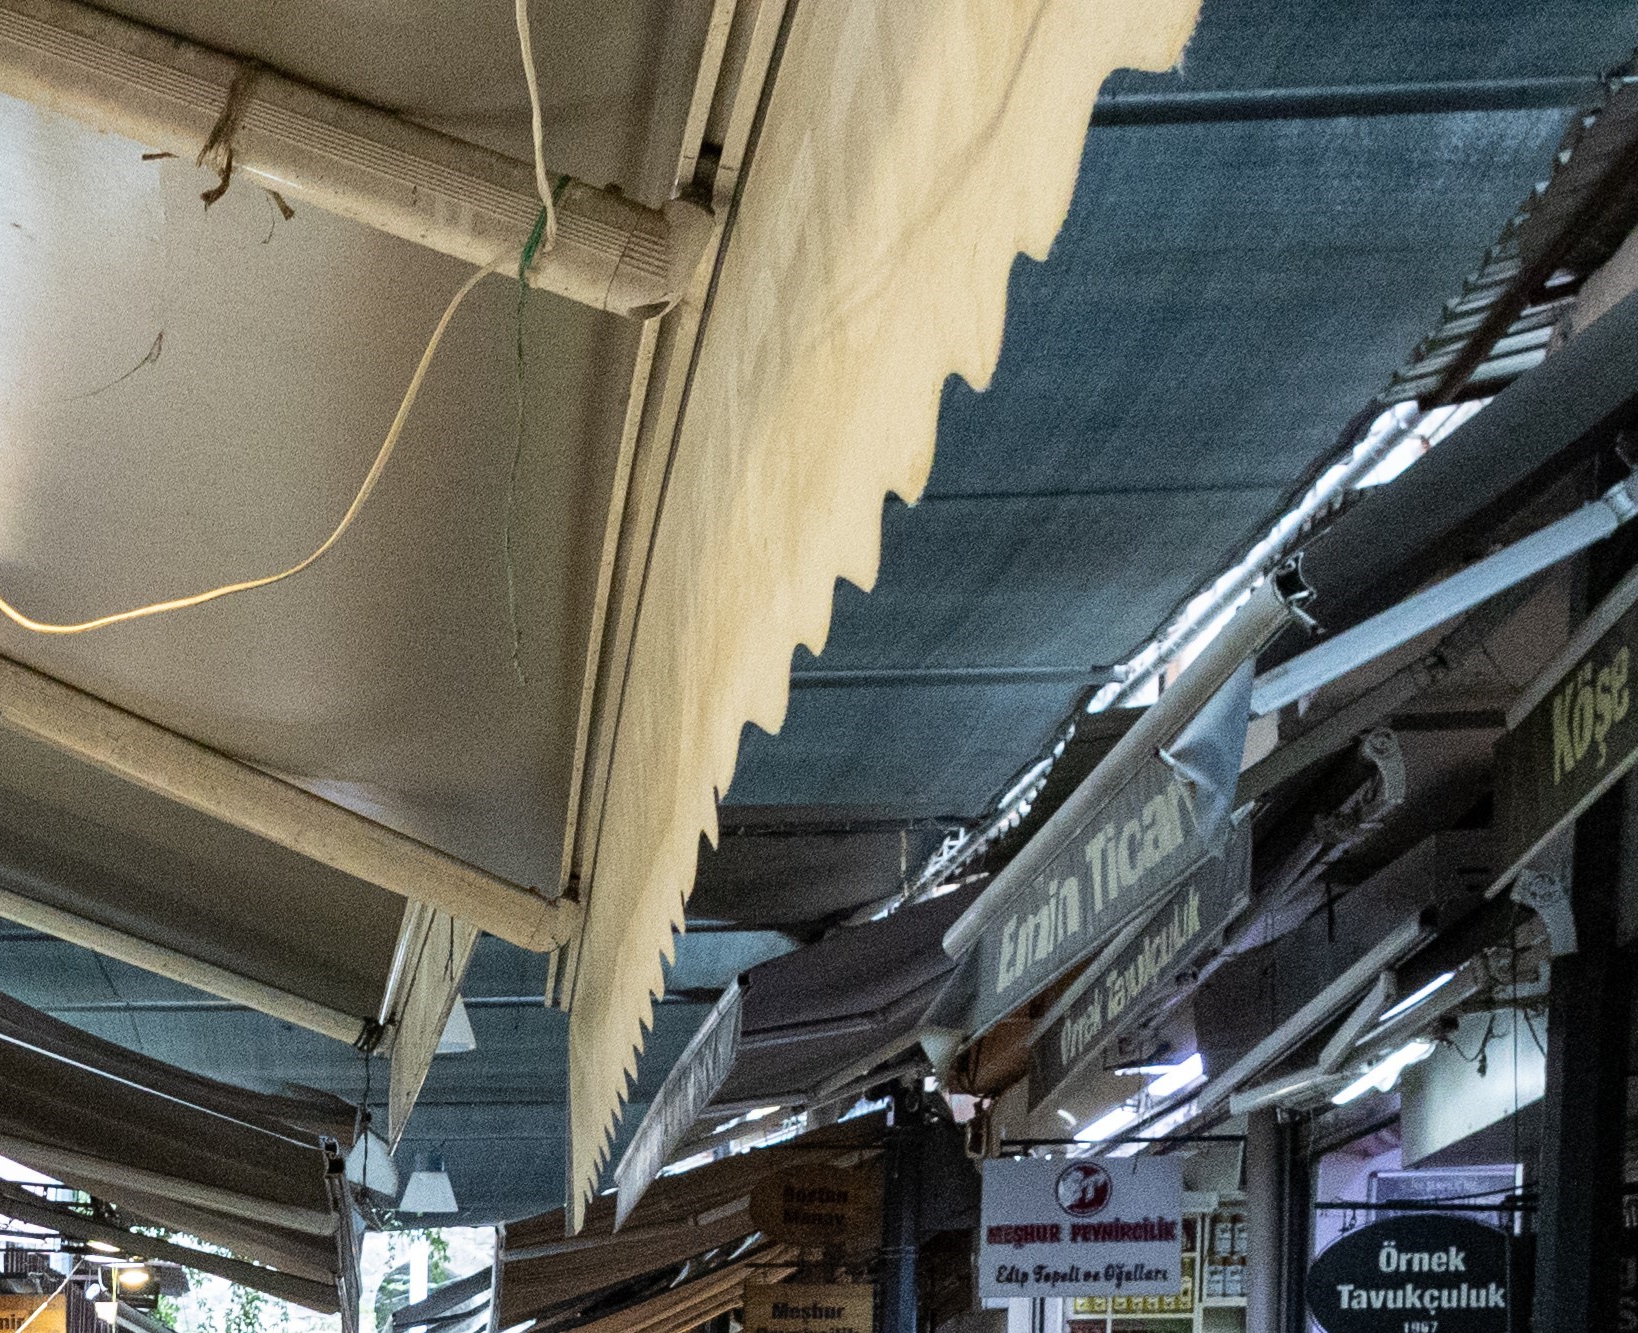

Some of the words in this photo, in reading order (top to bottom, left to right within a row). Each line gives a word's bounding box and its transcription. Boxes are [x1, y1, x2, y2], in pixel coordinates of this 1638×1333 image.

[996, 876, 1081, 993] Emin
[986, 1223, 1063, 1249] MEŞHUR
[1069, 1216, 1176, 1243] PEYNİRCİLİK
[1377, 1240, 1467, 1273] Örnek
[1336, 1282, 1507, 1316] Tavukçuluk
